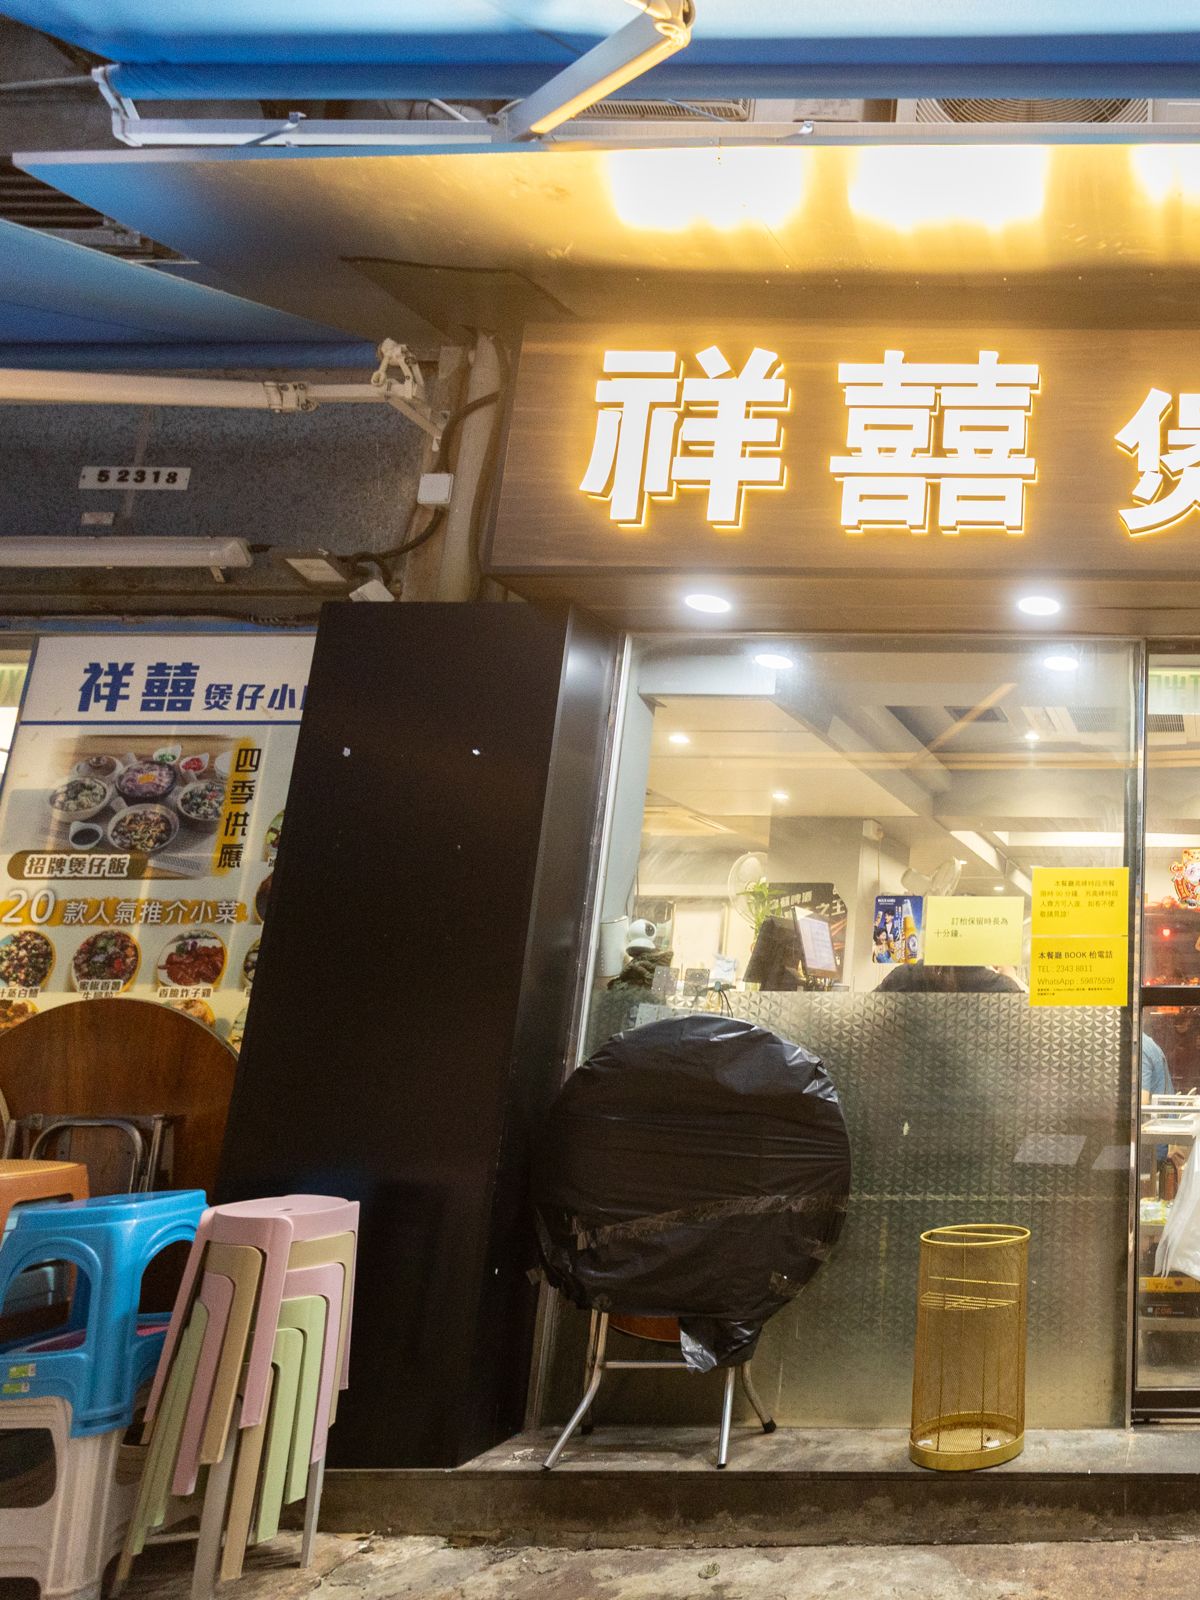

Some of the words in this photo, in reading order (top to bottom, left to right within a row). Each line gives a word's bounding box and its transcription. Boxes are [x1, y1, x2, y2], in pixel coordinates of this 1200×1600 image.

[579, 345, 1041, 534] 祥囍
[97, 469, 178, 484] 52318
[77, 662, 200, 712] 祥囍
[202, 683, 309, 711] 煲仔小
[217, 747, 261, 870] 四季供應
[25, 856, 129, 876] 招牌煲仔飯
[2, 889, 56, 924] 20
[63, 901, 240, 925] 款人氣推介小菜
[1064, 951, 1087, 959] BOOK
